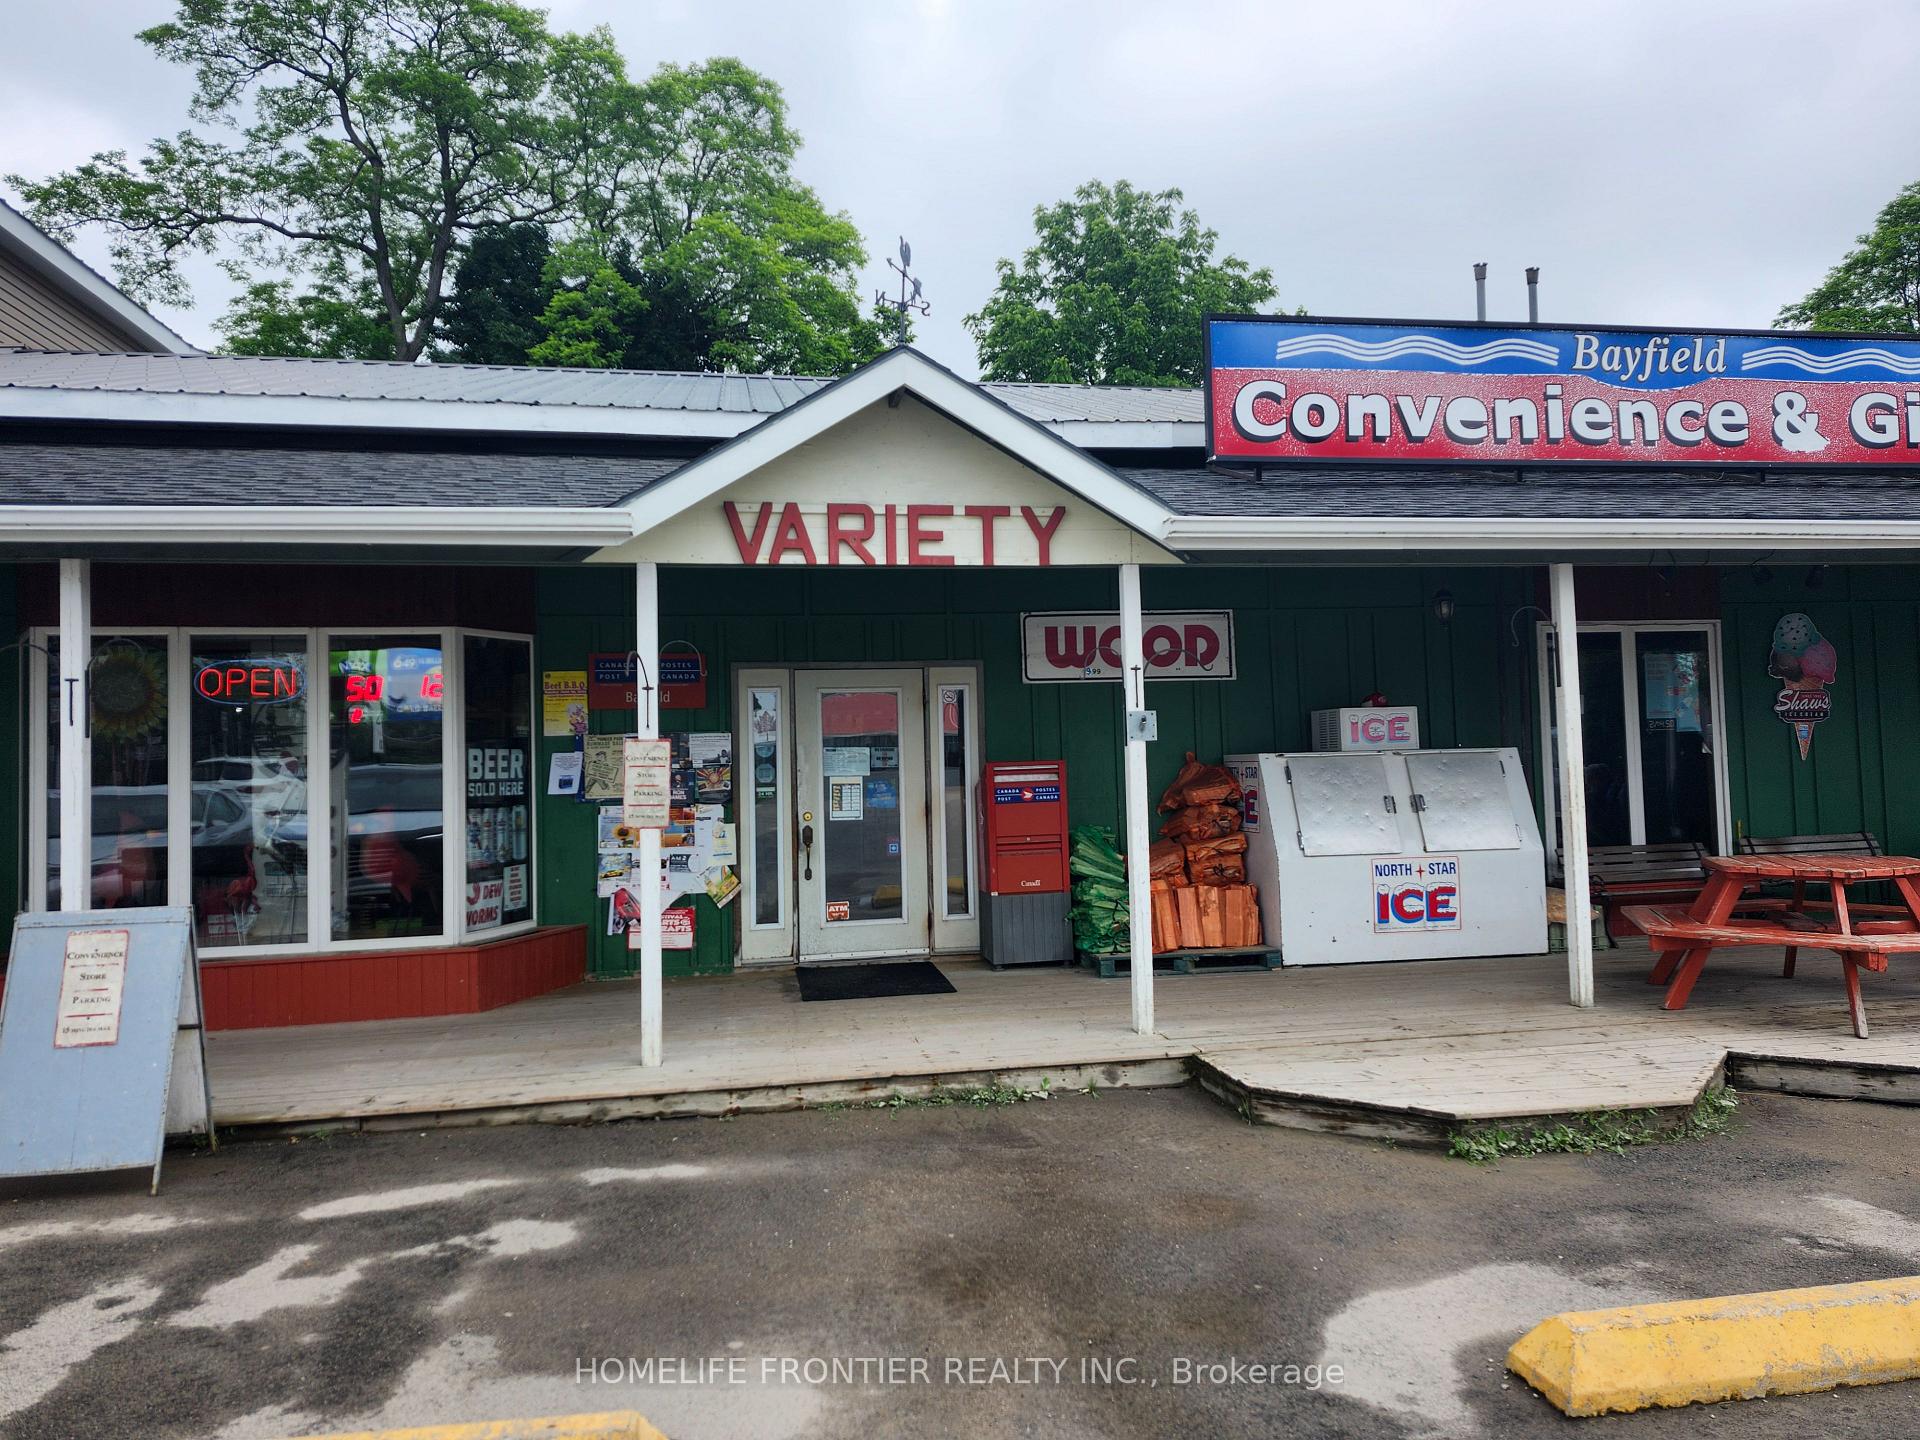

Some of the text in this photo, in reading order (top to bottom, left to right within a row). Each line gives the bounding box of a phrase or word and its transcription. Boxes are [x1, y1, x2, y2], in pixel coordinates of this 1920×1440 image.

[1572, 334, 1727, 382] Bayfield
[1234, 379, 1750, 446] Convenience
[1772, 390, 1830, 452] &
[723, 501, 1067, 567] VARIETY
[199, 668, 298, 697] OPEN
[346, 674, 385, 703] 50
[1775, 690, 1829, 711] Shaw's
[1349, 713, 1411, 744] ICE
[467, 747, 525, 780] BEER
[1245, 766, 1258, 779] STAR
[467, 781, 525, 797] SOLD HERE
[633, 789, 663, 797] PARKING
[1375, 862, 1457, 877] NORTH STAR
[482, 883, 504, 900] DEW
[828, 904, 849, 913] ATM
[1376, 882, 1458, 924] ICE
[66, 950, 125, 961] CONVENIENCE
[79, 971, 108, 981] STORE
[72, 995, 112, 1005] PARKING
